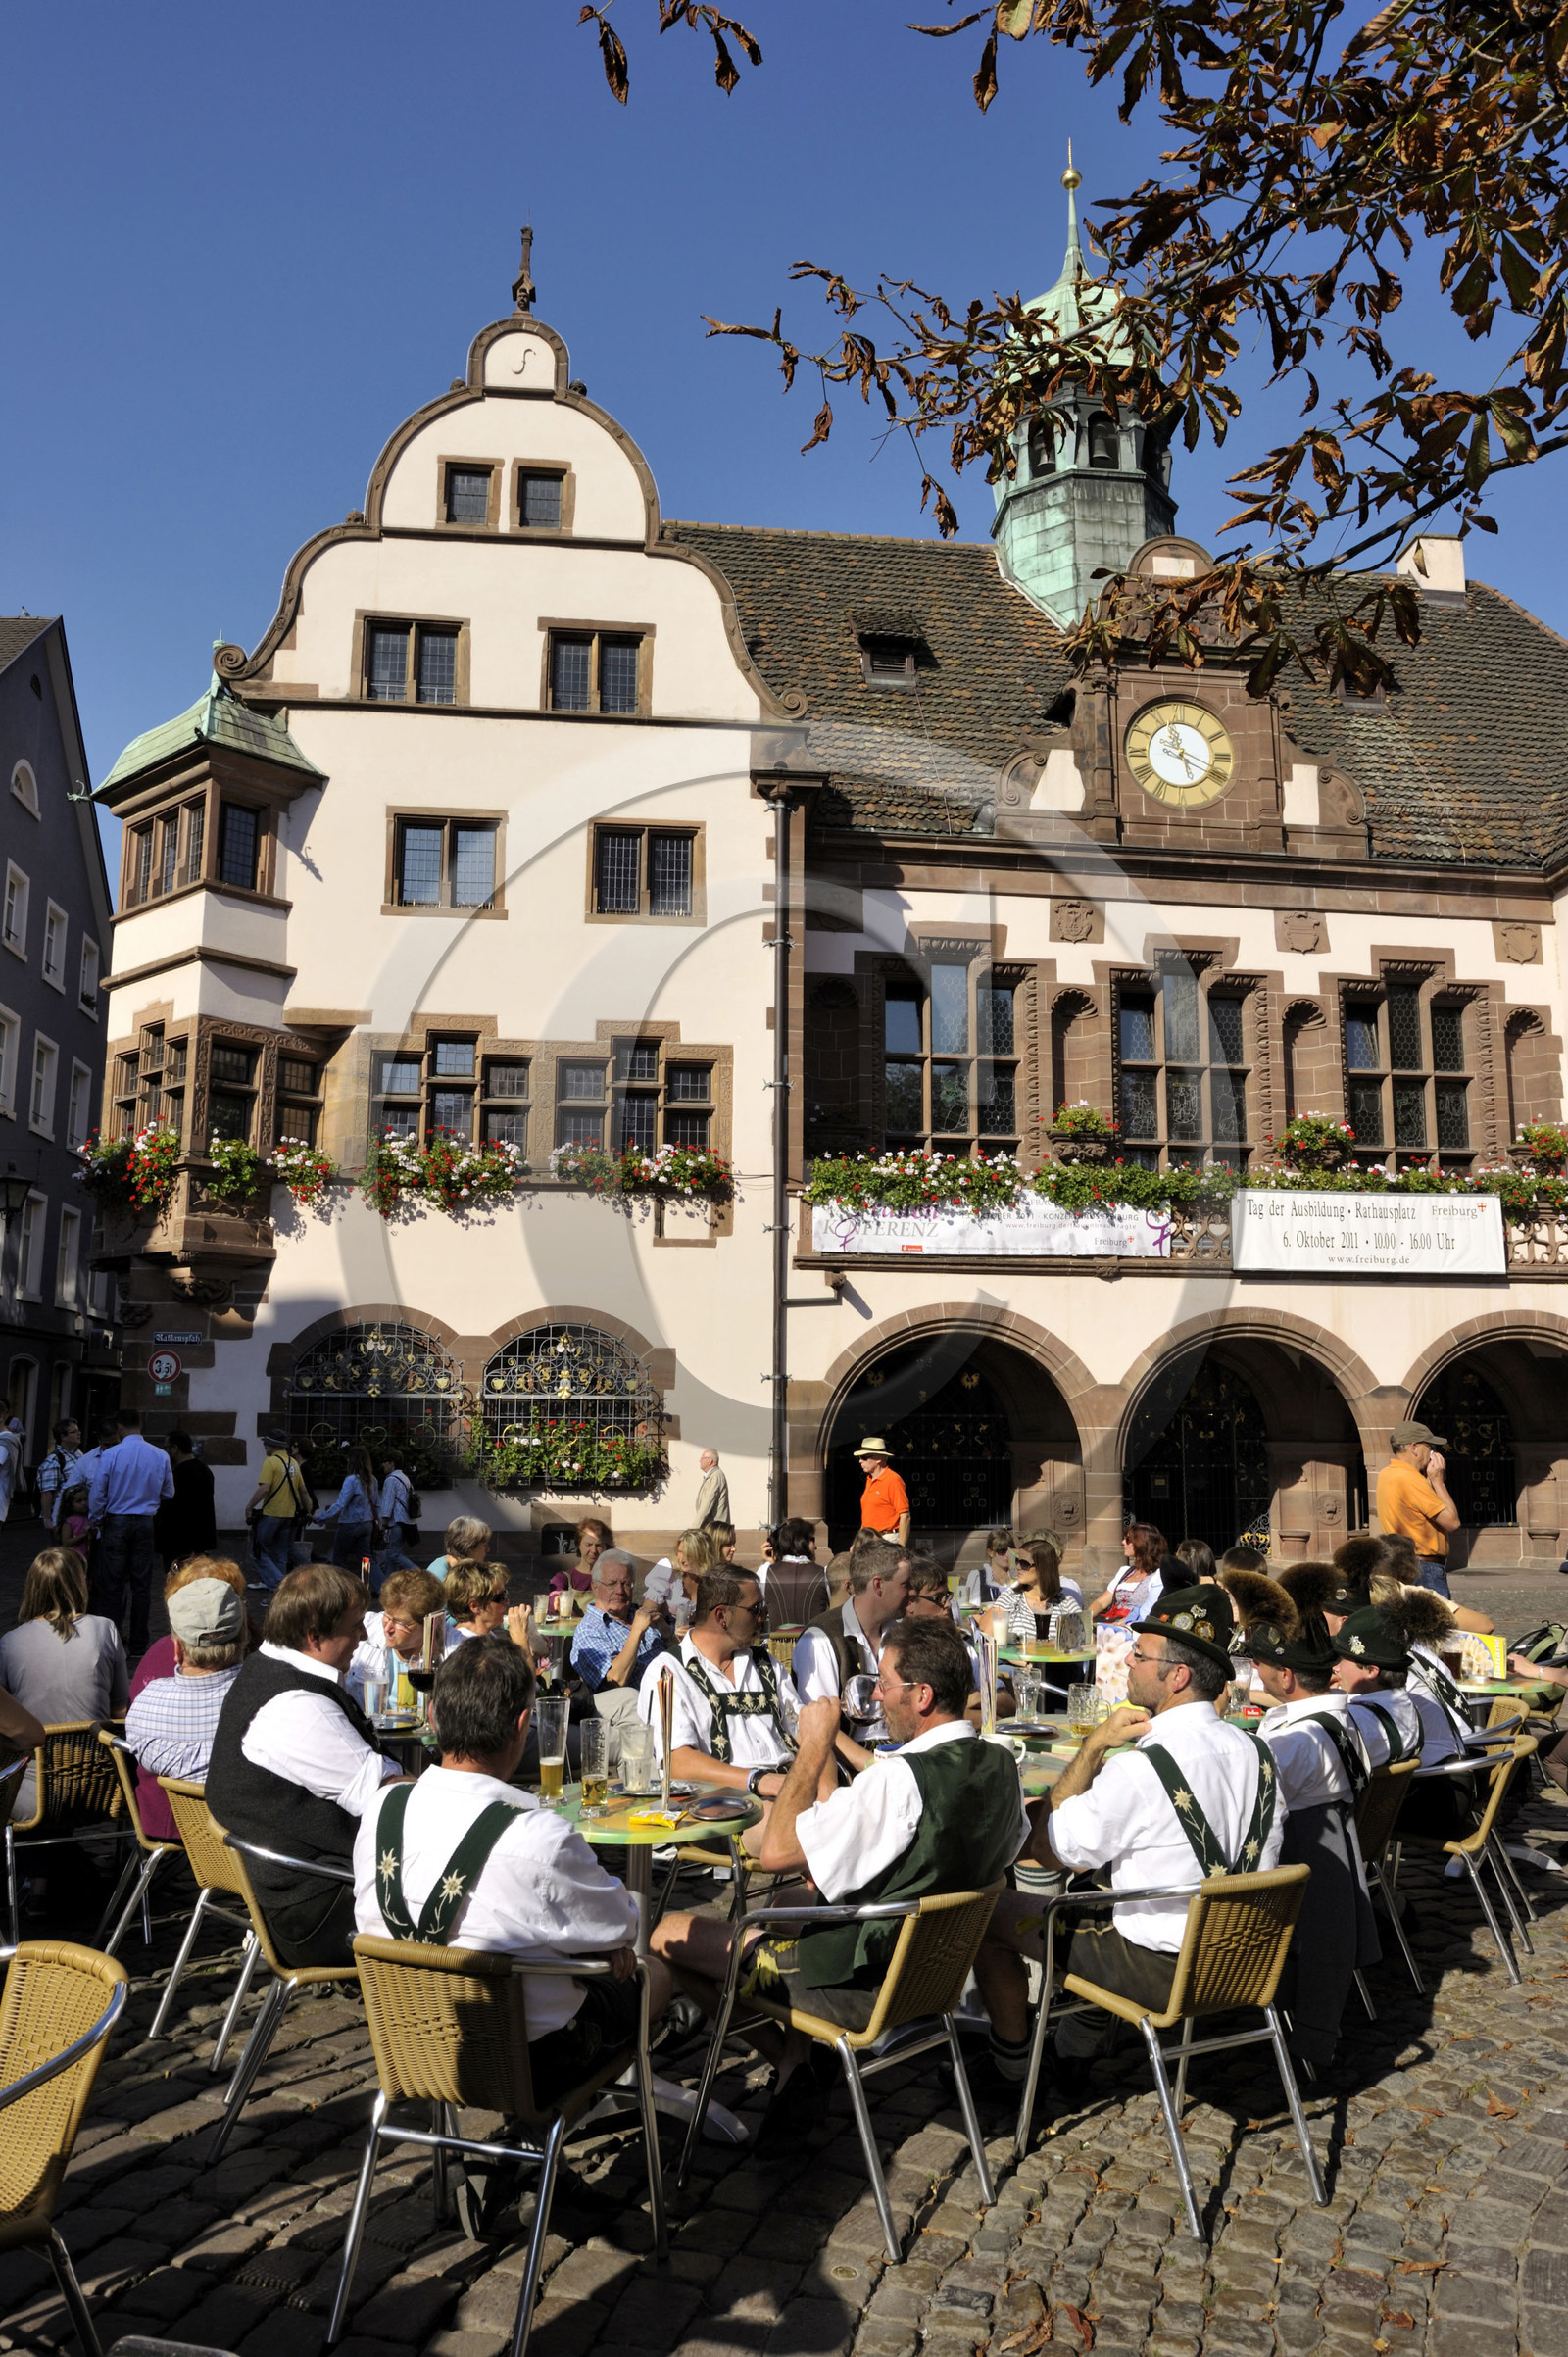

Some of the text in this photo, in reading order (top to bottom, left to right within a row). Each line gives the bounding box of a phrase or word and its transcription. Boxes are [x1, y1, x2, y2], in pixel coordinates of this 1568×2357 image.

[1247, 1199, 1416, 1223] Tag der Ausbildung Rathausplatz
[1432, 1205, 1478, 1219] Freiburg
[1095, 1237, 1127, 1248] Freiburg
[1283, 1231, 1292, 1248] 6.
[1297, 1230, 1335, 1248] Oktober
[1341, 1231, 1359, 1249] 2011
[1374, 1232, 1396, 1249] 10.00
[1409, 1232, 1432, 1250] 16.00
[1437, 1232, 1455, 1250] Uhr
[1328, 1254, 1410, 1265] www.freiburg.de
